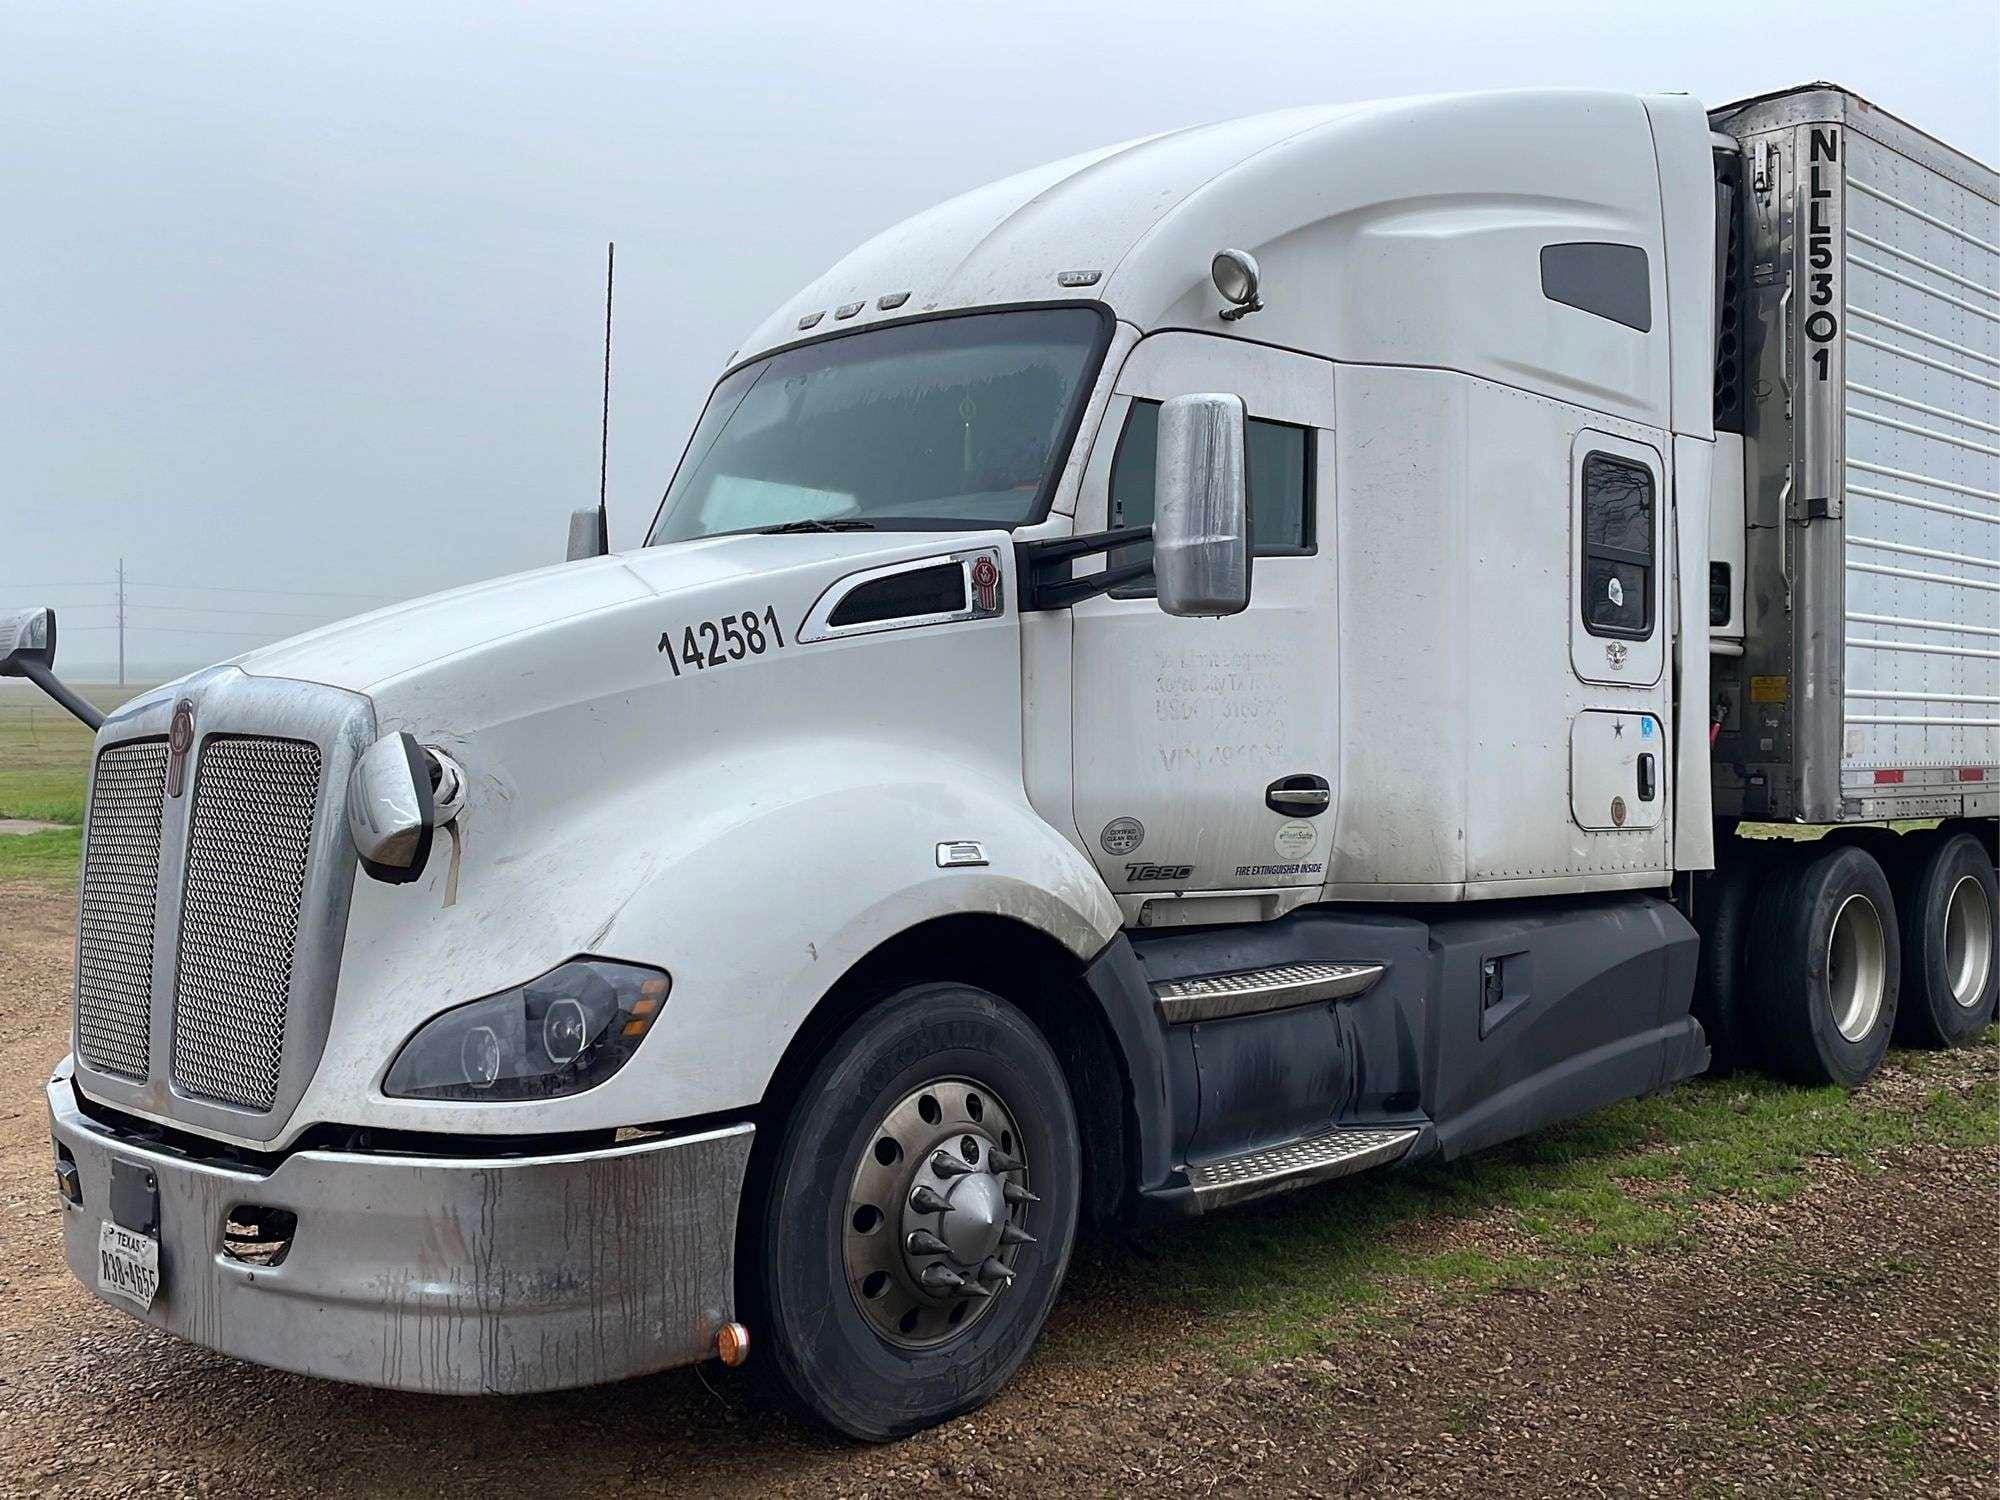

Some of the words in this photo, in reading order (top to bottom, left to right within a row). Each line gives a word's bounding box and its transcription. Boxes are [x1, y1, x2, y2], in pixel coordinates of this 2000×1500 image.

[1804, 128, 1838, 382] NLL5301
[657, 605, 785, 677] 142581
[1125, 862, 1195, 882] T680
[1235, 866, 1251, 876] FIRE
[1251, 864, 1300, 876] EXTINGUISHER
[1300, 863, 1322, 874] INSIDE
[117, 1232, 141, 1253] TEXAS
